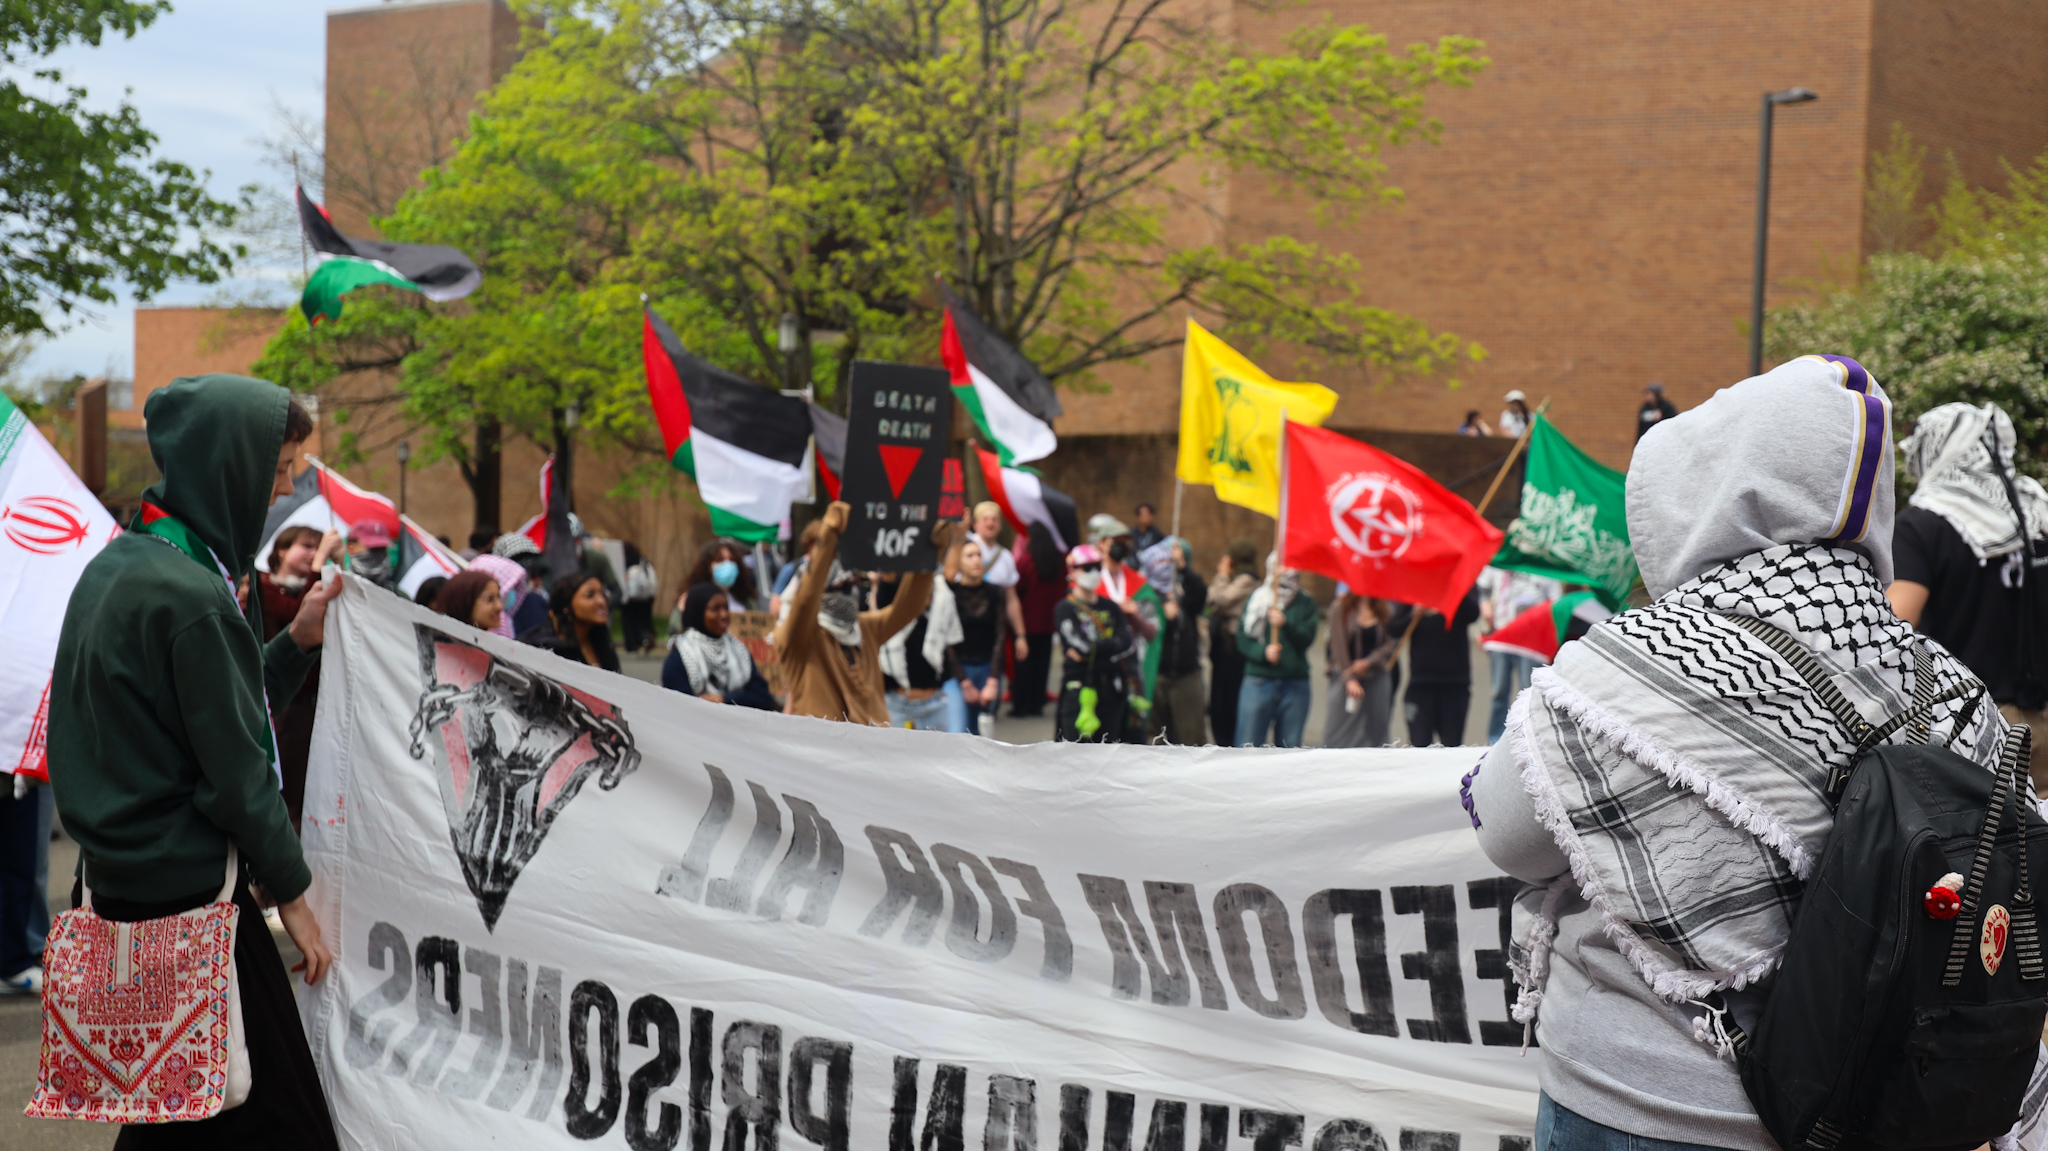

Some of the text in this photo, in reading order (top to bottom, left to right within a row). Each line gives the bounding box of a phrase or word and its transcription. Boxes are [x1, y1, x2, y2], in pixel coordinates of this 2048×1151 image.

[873, 389, 937, 414] DEATH
[877, 418, 932, 440] DEATH
[864, 501, 888, 520] TO
[874, 526, 920, 557] IOF
